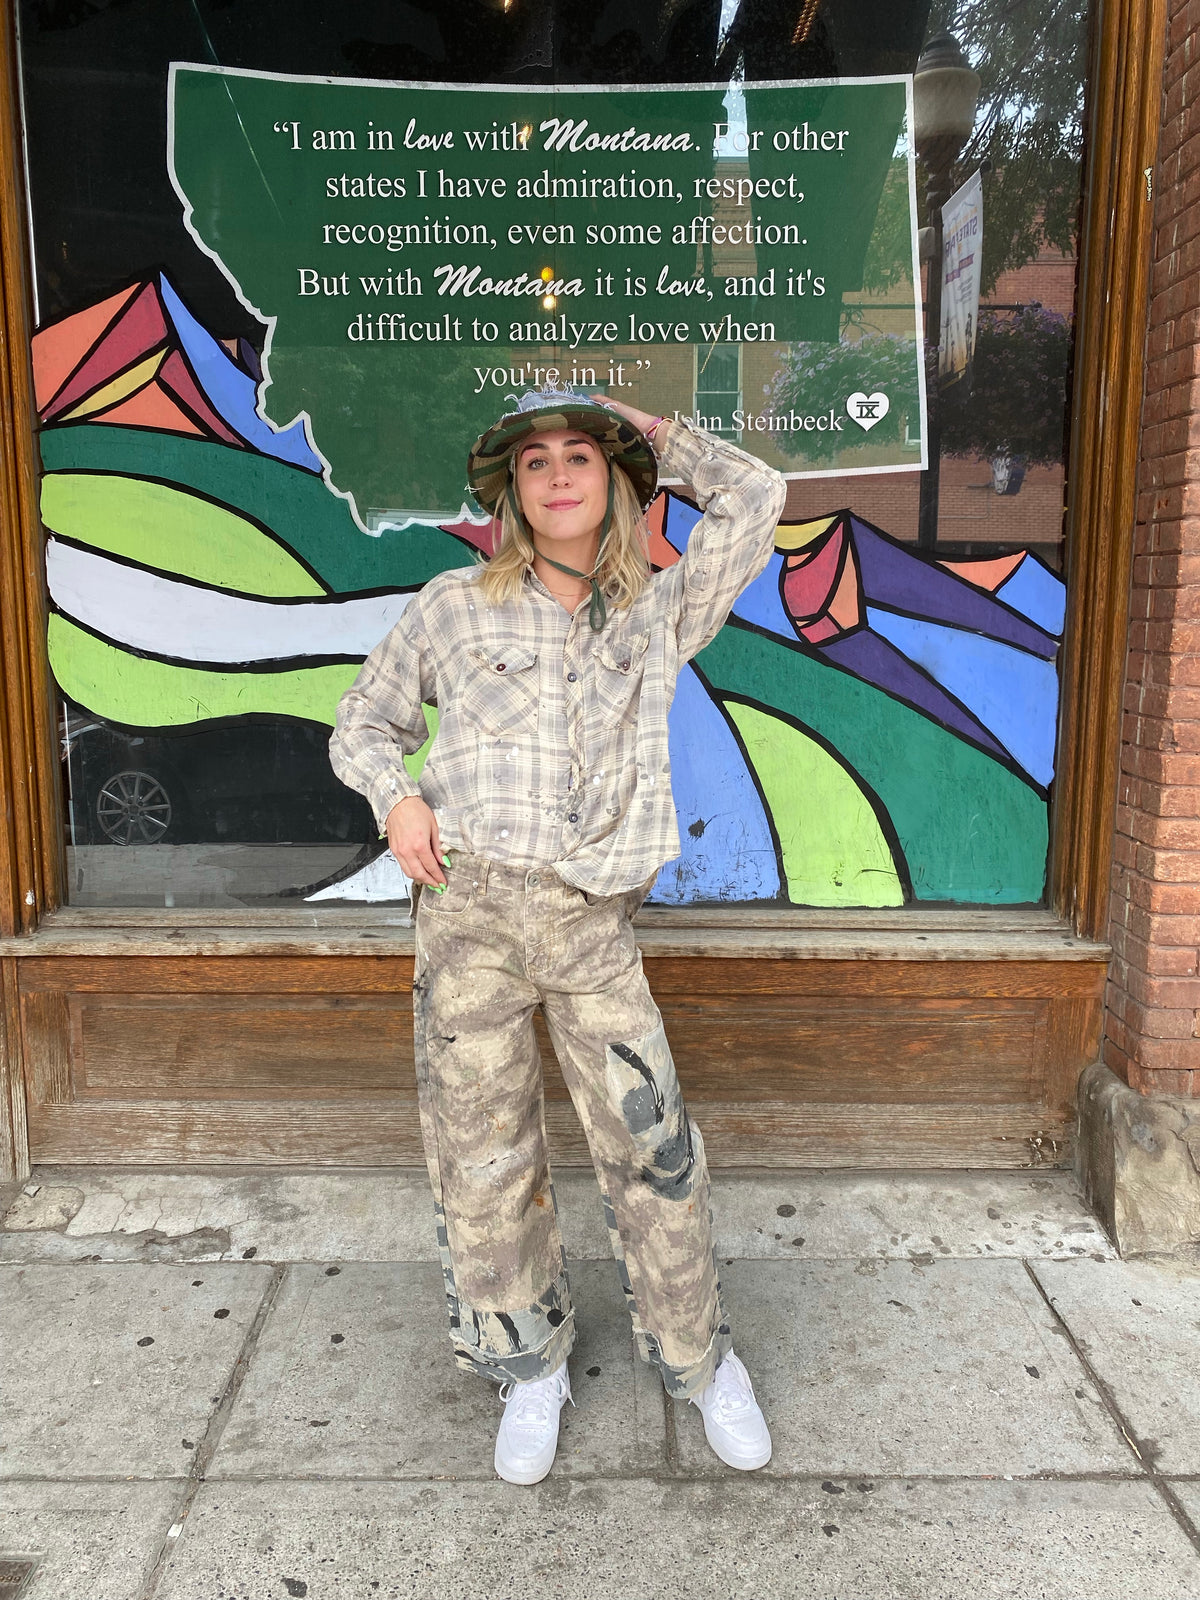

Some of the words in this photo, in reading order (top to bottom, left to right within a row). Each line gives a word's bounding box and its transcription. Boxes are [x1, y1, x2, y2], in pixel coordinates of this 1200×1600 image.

[273, 121, 302, 150] “I
[312, 130, 357, 150] am
[367, 121, 395, 150] in
[402, 117, 455, 151] love
[463, 121, 529, 151] with
[539, 117, 701, 153] Montana.
[711, 122, 765, 151] For
[773, 121, 850, 151] other
[326, 173, 407, 198] states
[416, 170, 428, 198] I
[437, 169, 506, 198] have
[516, 169, 683, 203] admiration,
[692, 173, 805, 206] respect,
[322, 215, 497, 252] recognition,
[507, 224, 576, 245] even
[586, 225, 662, 245] some
[671, 216, 808, 245] affection.
[297, 268, 350, 296] But
[359, 267, 423, 296] with
[433, 263, 586, 297] Montana
[595, 268, 615, 296] it
[624, 267, 647, 296] is
[655, 264, 714, 301] love,
[724, 267, 777, 296] and
[786, 267, 826, 296] it's
[347, 313, 463, 342] difficult
[471, 318, 499, 342] to
[509, 314, 618, 348] analyze
[628, 314, 689, 342] love
[698, 314, 776, 342] when
[473, 361, 560, 393] you're
[570, 359, 597, 387] in
[607, 359, 651, 388] it.”
[731, 409, 844, 431] Steinbeck
